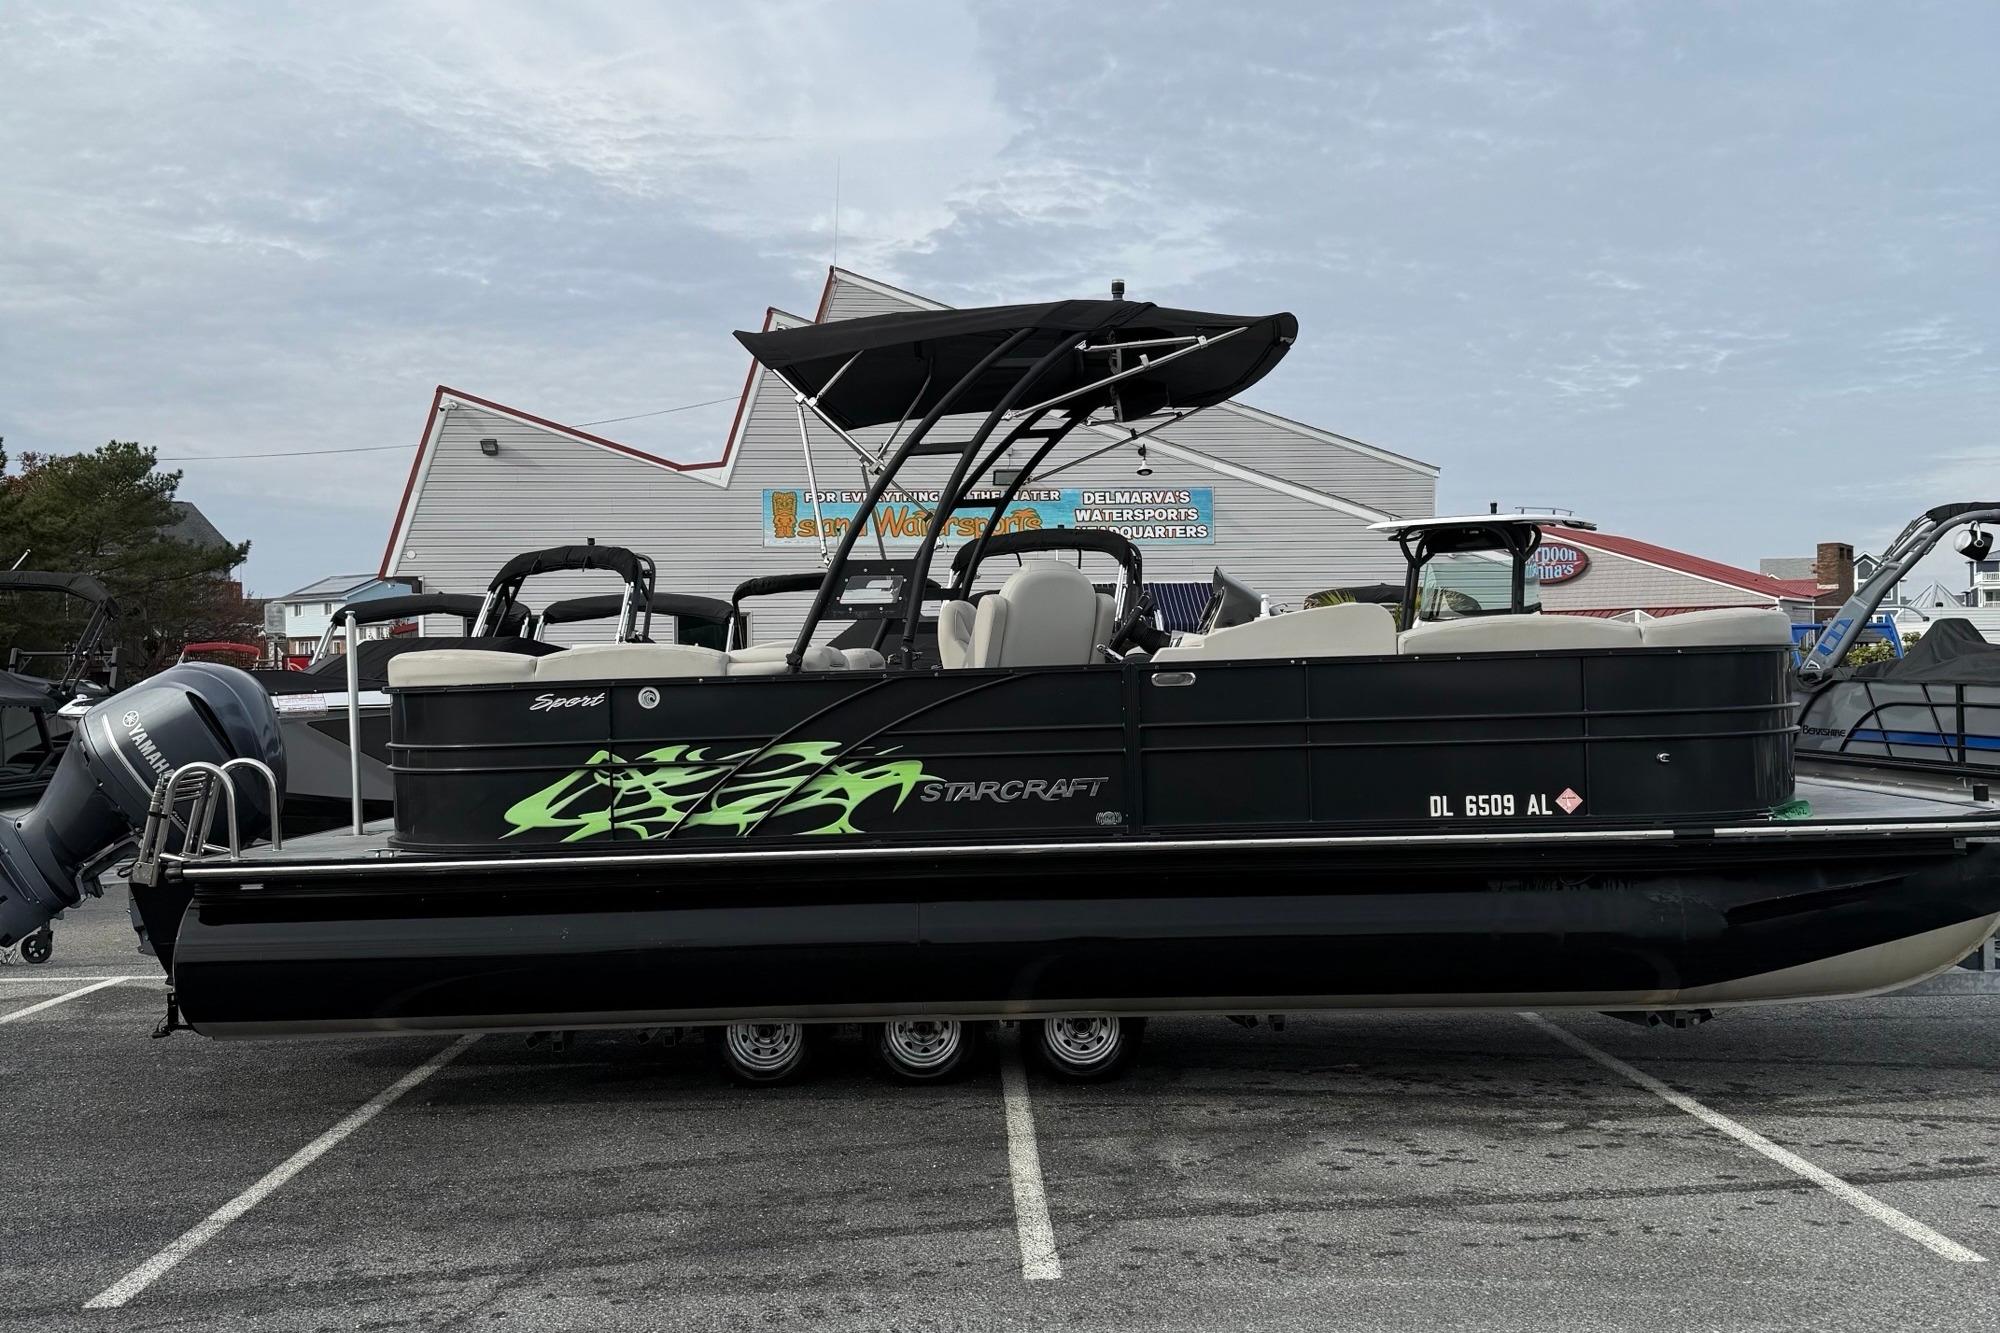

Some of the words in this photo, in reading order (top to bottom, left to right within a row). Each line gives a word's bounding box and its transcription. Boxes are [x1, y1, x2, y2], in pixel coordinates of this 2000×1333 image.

[841, 491, 939, 502] EVYTHING
[1082, 491, 1191, 505] DELMARVA'S
[1075, 508, 1199, 521] WATERSPORTS
[1534, 546, 1578, 562] rpoon
[529, 692, 606, 712] Sport
[920, 776, 1110, 803] STARCRAFT
[1429, 795, 1454, 817] DL
[1465, 794, 1515, 817] 6509
[1527, 793, 1553, 816] AL
